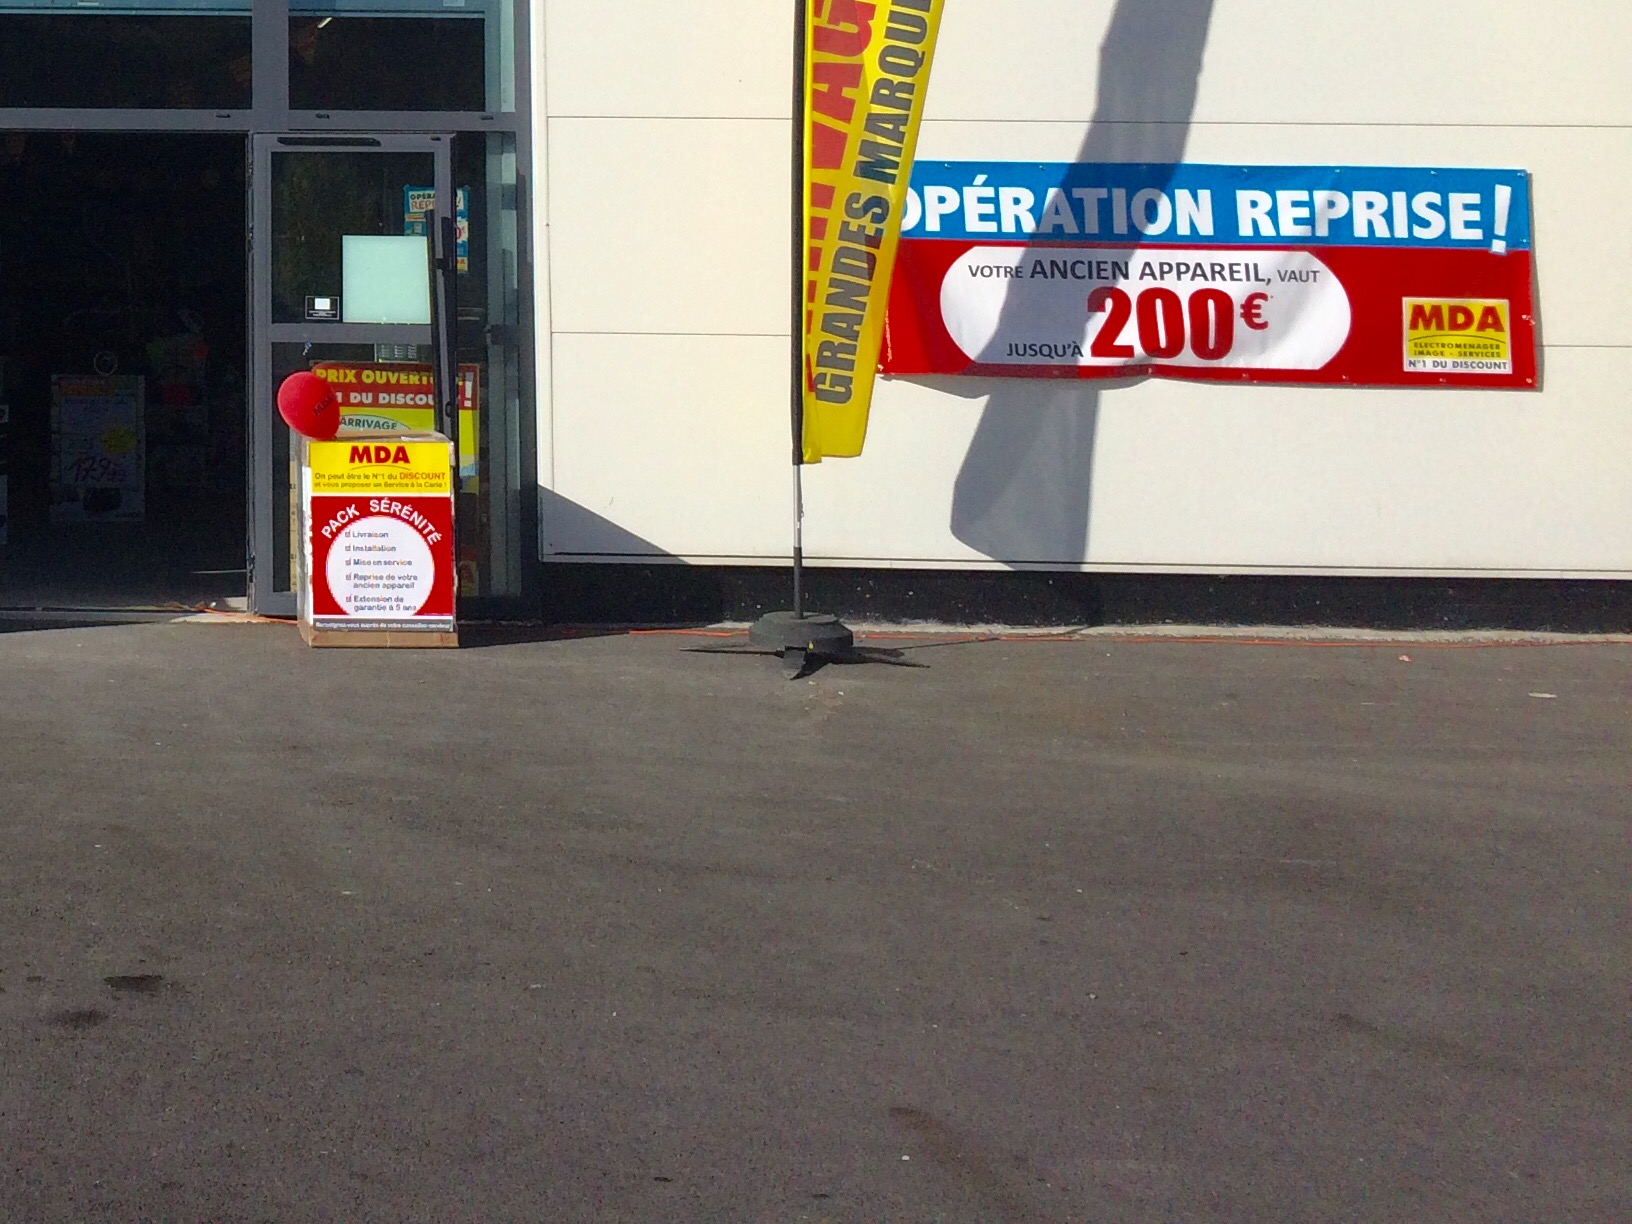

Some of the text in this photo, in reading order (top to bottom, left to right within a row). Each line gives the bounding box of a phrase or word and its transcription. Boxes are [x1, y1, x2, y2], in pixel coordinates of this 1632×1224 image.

[1237, 189, 1482, 242] REPRISE
[968, 258, 1320, 287] VOTRE ANCIEN APPAREIL, VAUT
[813, 191, 891, 405] GRANDES
[1408, 304, 1506, 333] MDA
[1413, 342, 1501, 350] ELECTROMENAGER
[1452, 361, 1508, 370] DISCOUNT
[349, 392, 373, 403] DU
[340, 417, 398, 431] ARRIVAGE
[348, 445, 411, 464] MDA
[399, 472, 446, 480] DISCOUNT
[321, 497, 443, 546] PACK SÉRÉNITÉ
[353, 573, 384, 582] Reprise
[353, 595, 393, 603] Extension
